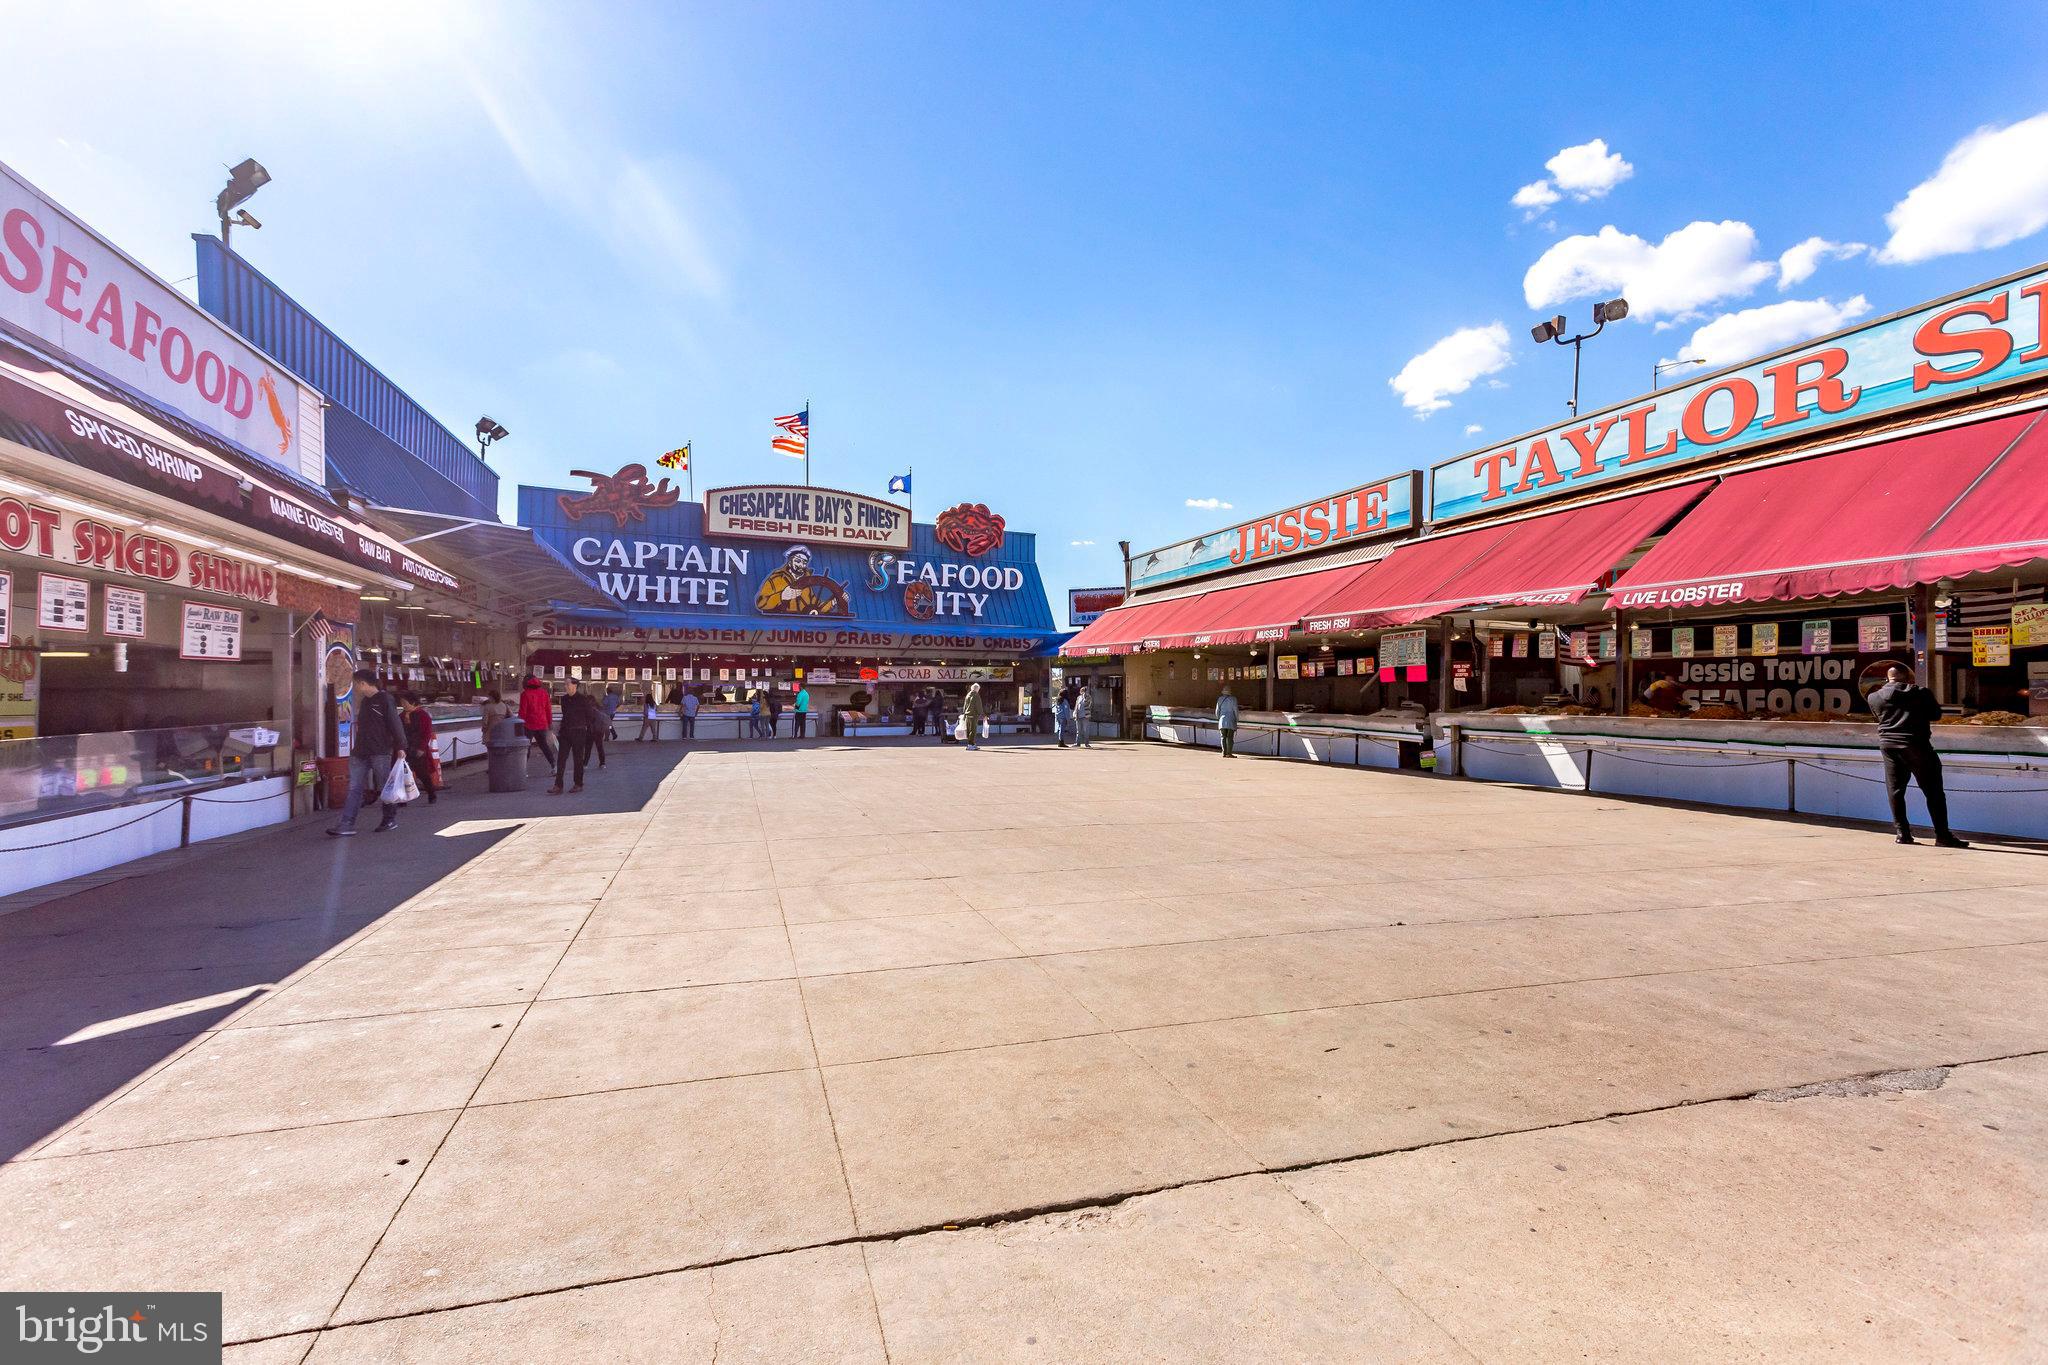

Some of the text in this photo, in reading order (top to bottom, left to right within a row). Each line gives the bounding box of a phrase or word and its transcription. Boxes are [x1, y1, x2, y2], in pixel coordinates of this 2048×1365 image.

[0, 208, 254, 419] SEAFOOD
[1474, 347, 1862, 502] TAYLOR
[65, 409, 203, 483] SPICED SHRIMP
[719, 492, 900, 530] CHESAPEAKE BAY'S FINEST
[304, 511, 345, 544] LOBSTER
[728, 517, 892, 542] FRESH FISH DAILY
[1229, 483, 1389, 565] JESSIE
[359, 537, 376, 558] RAW
[573, 537, 749, 575] CAPTAIN
[73, 518, 181, 581] SPICED
[188, 550, 275, 603] SHRIMP
[597, 572, 729, 606] WHITE
[1622, 582, 1744, 606] LIVE LOBSTER
[203, 607, 222, 621] RAW
[224, 611, 239, 623] BAR
[1309, 618, 1350, 631] FRESH FISH
[2014, 607, 2038, 618] SEA
[195, 622, 212, 631] CLAMS
[542, 620, 623, 639] SHRIMP
[658, 627, 746, 642] LOBSTER
[766, 629, 892, 646] JUMBO CRABS
[1255, 628, 1284, 639] MUSSELS
[1973, 628, 2009, 636] SHRIMP
[911, 633, 1031, 650] COOKED CRABS
[898, 668, 968, 680] CRAB SALE
[1678, 656, 1856, 685] Jessie Taylor
[8, 693, 31, 701] SHE
[1681, 688, 1851, 715] SEAFOOD
